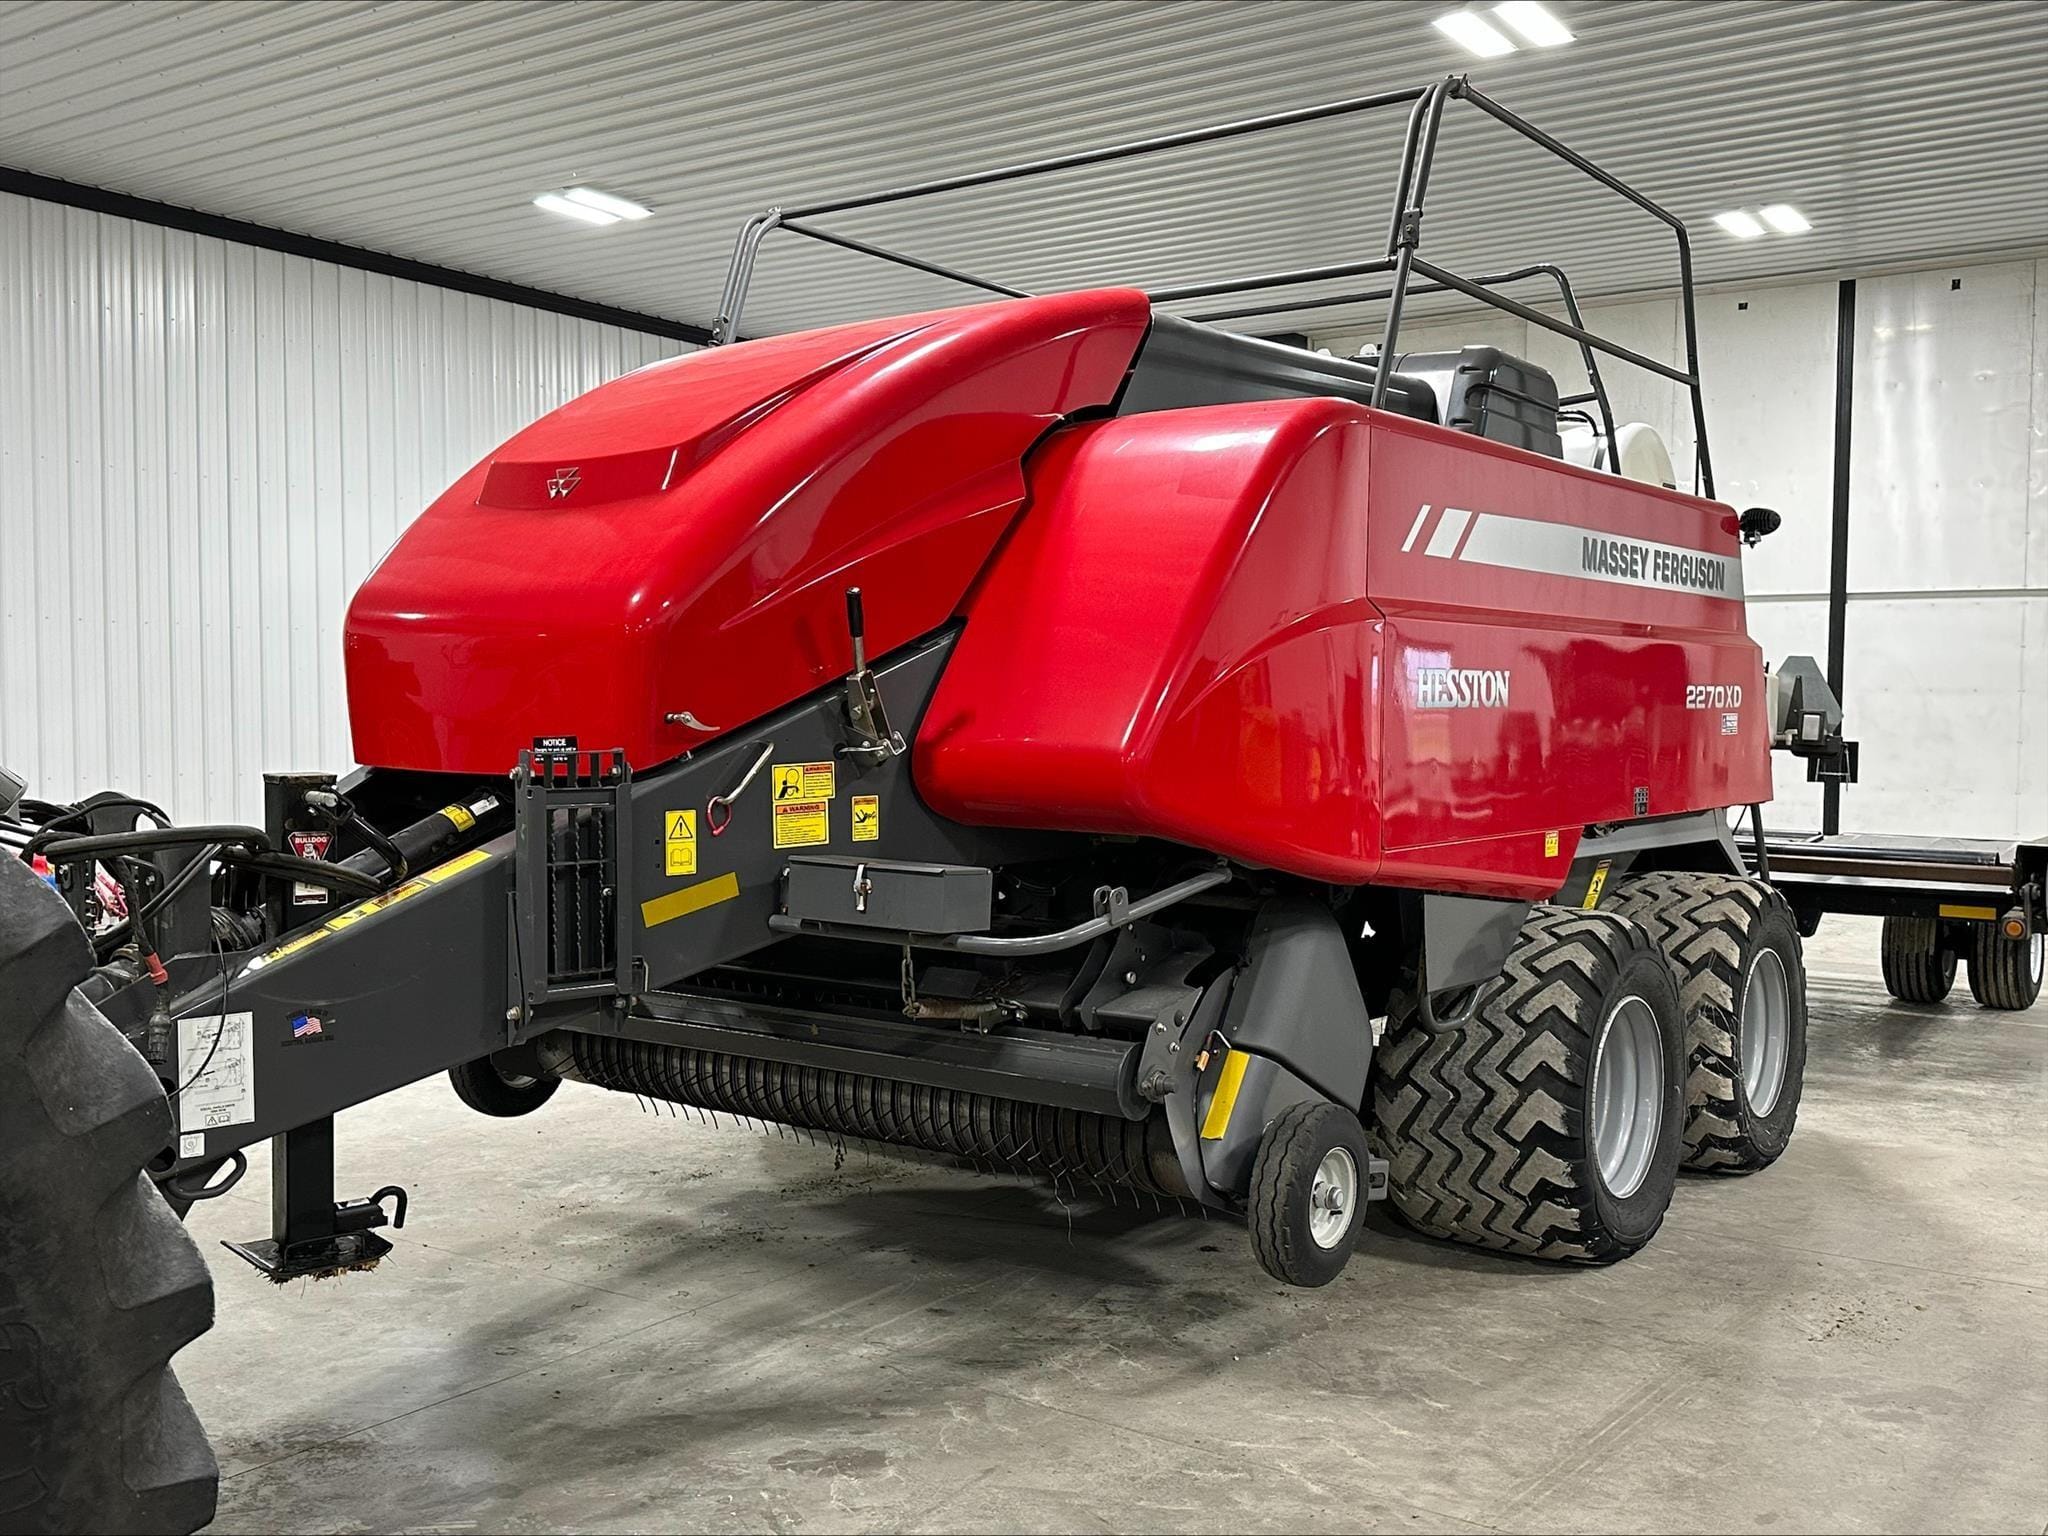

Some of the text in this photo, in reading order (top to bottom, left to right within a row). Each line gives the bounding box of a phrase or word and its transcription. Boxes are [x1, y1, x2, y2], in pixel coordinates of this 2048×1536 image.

[1582, 536, 1725, 591] MASSEY FERGUSON
[1417, 668, 1510, 708] HESSTON
[1686, 685, 1742, 709] 2270XD
[542, 738, 567, 746] NOTICE
[789, 804, 820, 812] WARNING
[295, 836, 327, 844] BULLDOG
